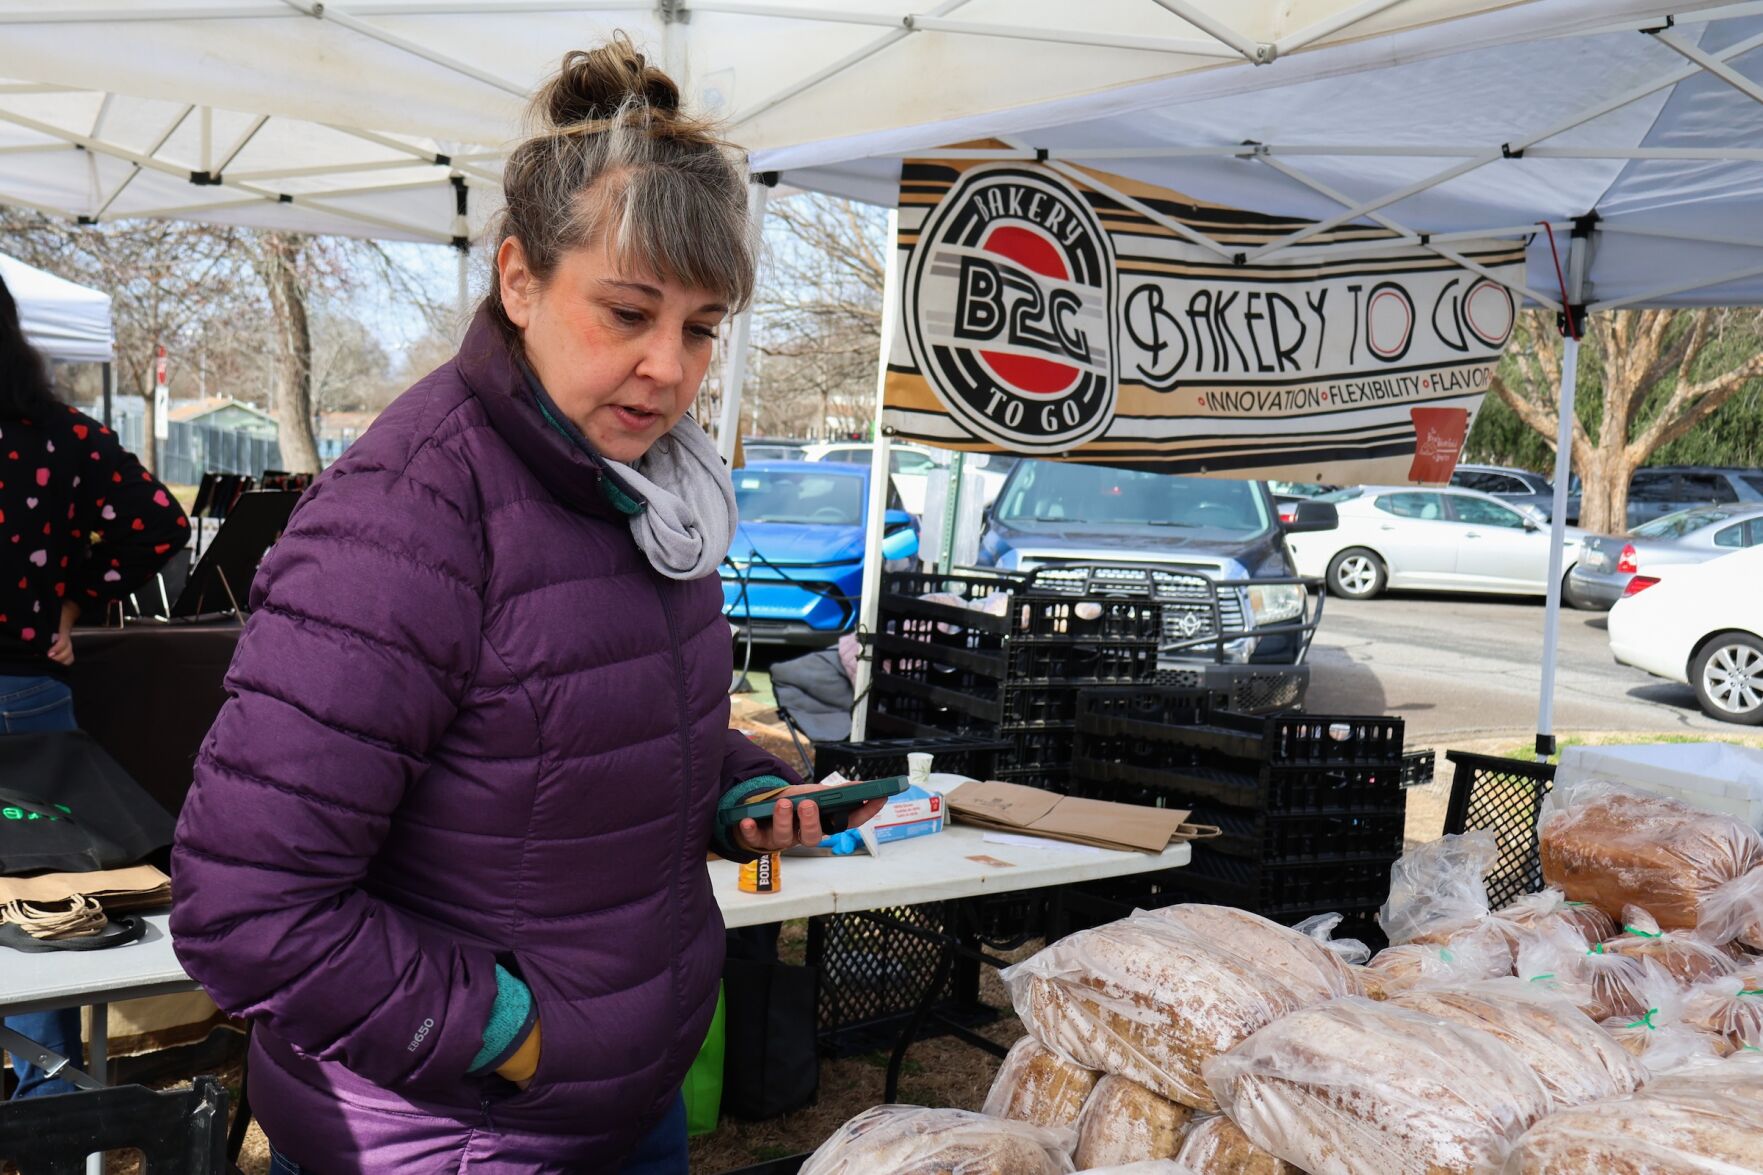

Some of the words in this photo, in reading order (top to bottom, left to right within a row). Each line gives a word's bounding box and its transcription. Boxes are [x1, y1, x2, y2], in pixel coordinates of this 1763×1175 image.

[973, 187, 1085, 246] BAKERY
[954, 255, 1092, 364] B2G
[1124, 283, 1329, 381] BAKERY
[1347, 281, 1416, 362] TO
[1432, 275, 1515, 351] GO
[984, 387, 1025, 427] TO
[1040, 400, 1081, 432] GO
[1205, 386, 1321, 412] INNOVATION
[1329, 375, 1420, 406] FLEXIBILITY
[1430, 367, 1490, 393] FLAVOR
[407, 1018, 434, 1052] EB650
